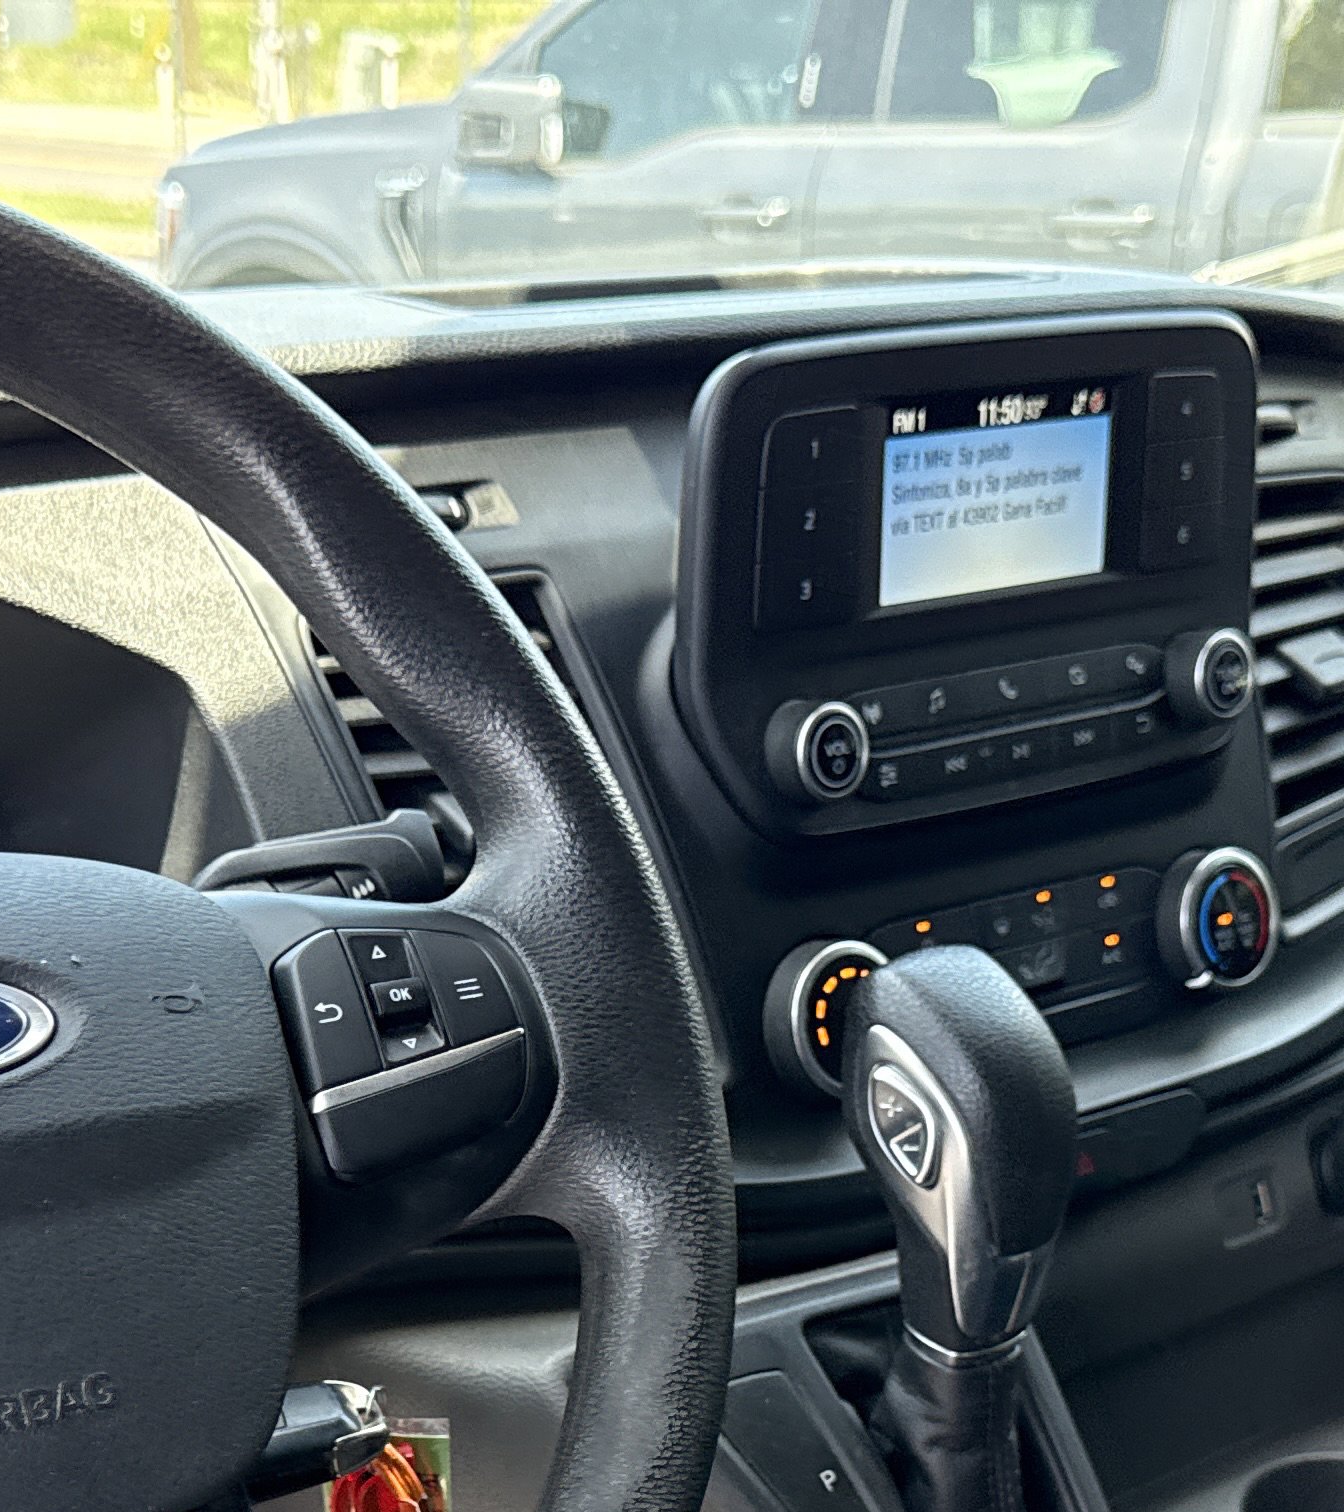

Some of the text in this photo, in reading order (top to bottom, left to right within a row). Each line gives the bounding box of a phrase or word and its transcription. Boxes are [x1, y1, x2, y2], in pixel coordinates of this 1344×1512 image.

[810, 438, 820, 460] 1
[803, 507, 817, 532] 2
[799, 577, 813, 601] 3
[388, 986, 414, 1003] OK
[818, 1468, 838, 1493] P
